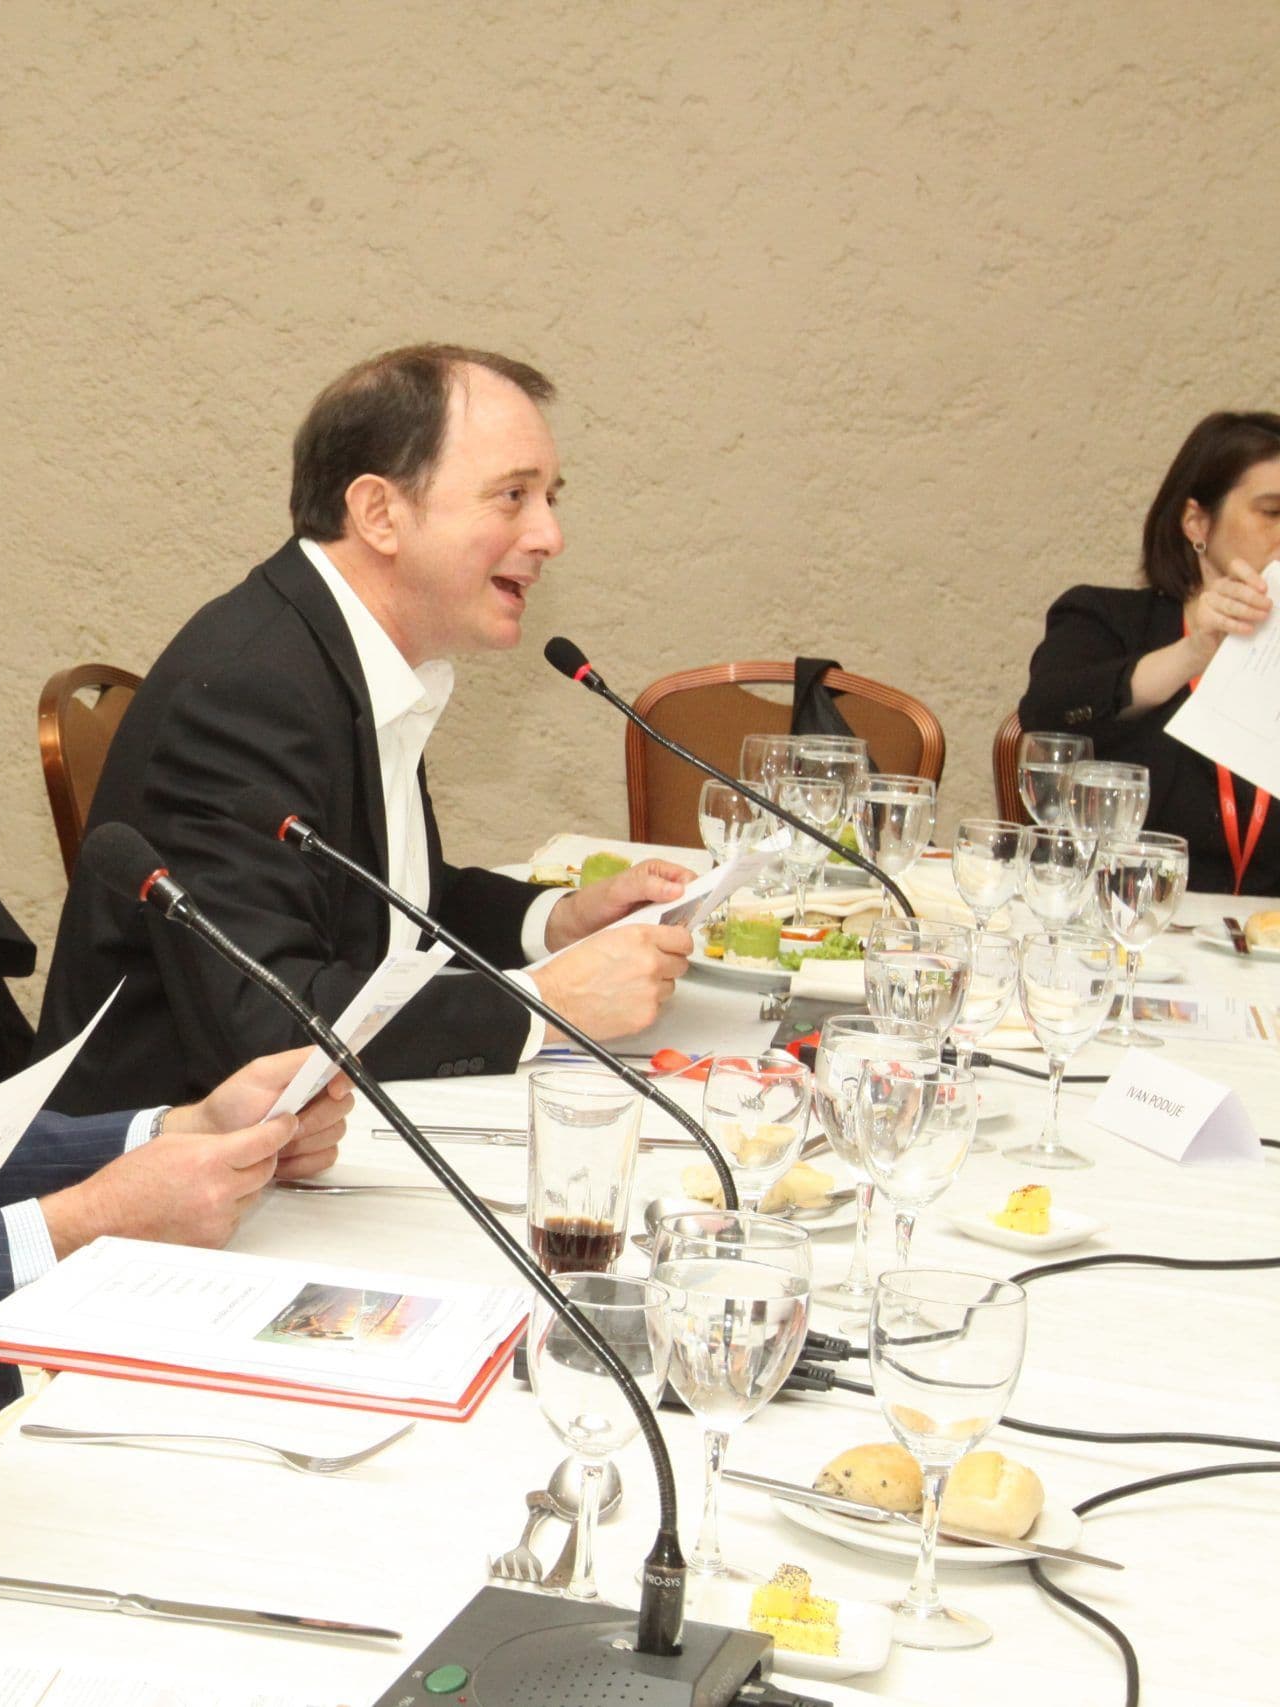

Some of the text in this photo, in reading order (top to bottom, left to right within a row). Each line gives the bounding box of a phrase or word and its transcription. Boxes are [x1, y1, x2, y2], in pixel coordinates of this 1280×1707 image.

[1127, 1086, 1185, 1117] IVAN PODUJE
[645, 1572, 681, 1588] PRO-SYS
